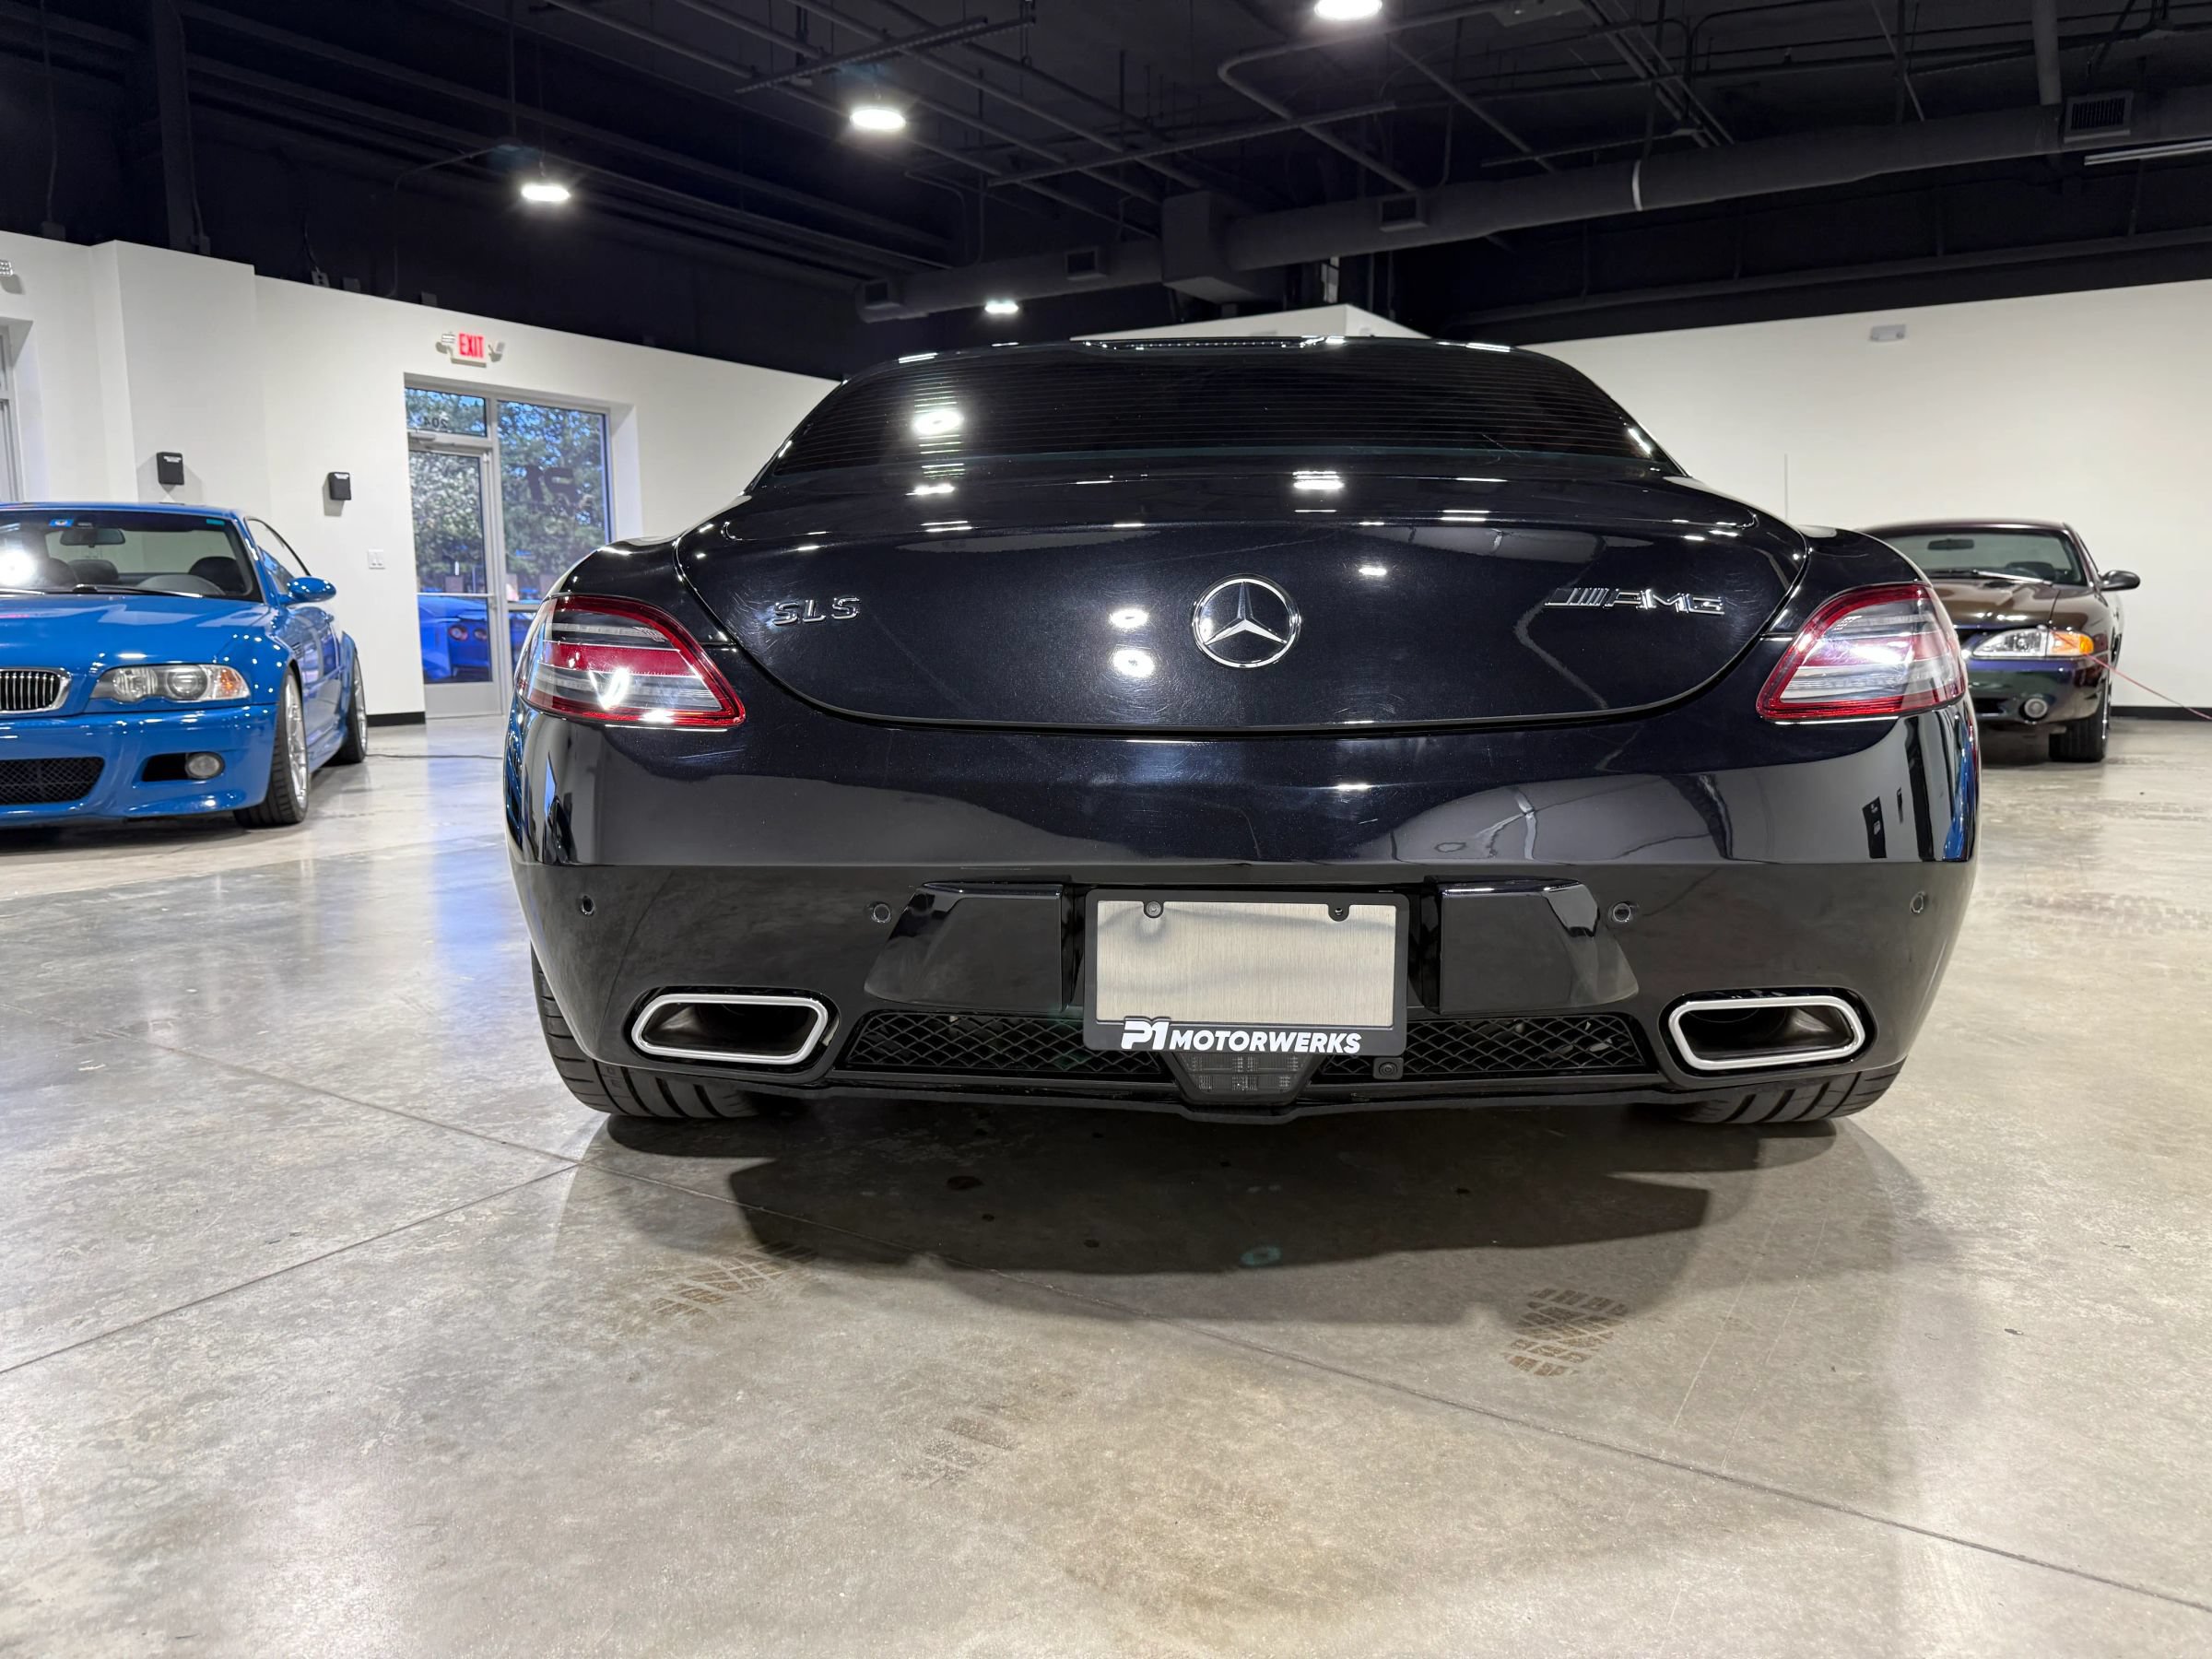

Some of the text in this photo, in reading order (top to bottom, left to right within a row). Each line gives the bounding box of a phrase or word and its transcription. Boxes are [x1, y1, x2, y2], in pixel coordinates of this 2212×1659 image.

[459, 333, 484, 358] EXIT
[772, 596, 861, 625] SLS
[1121, 1020, 1362, 1054] P1 MOTORWERKS
